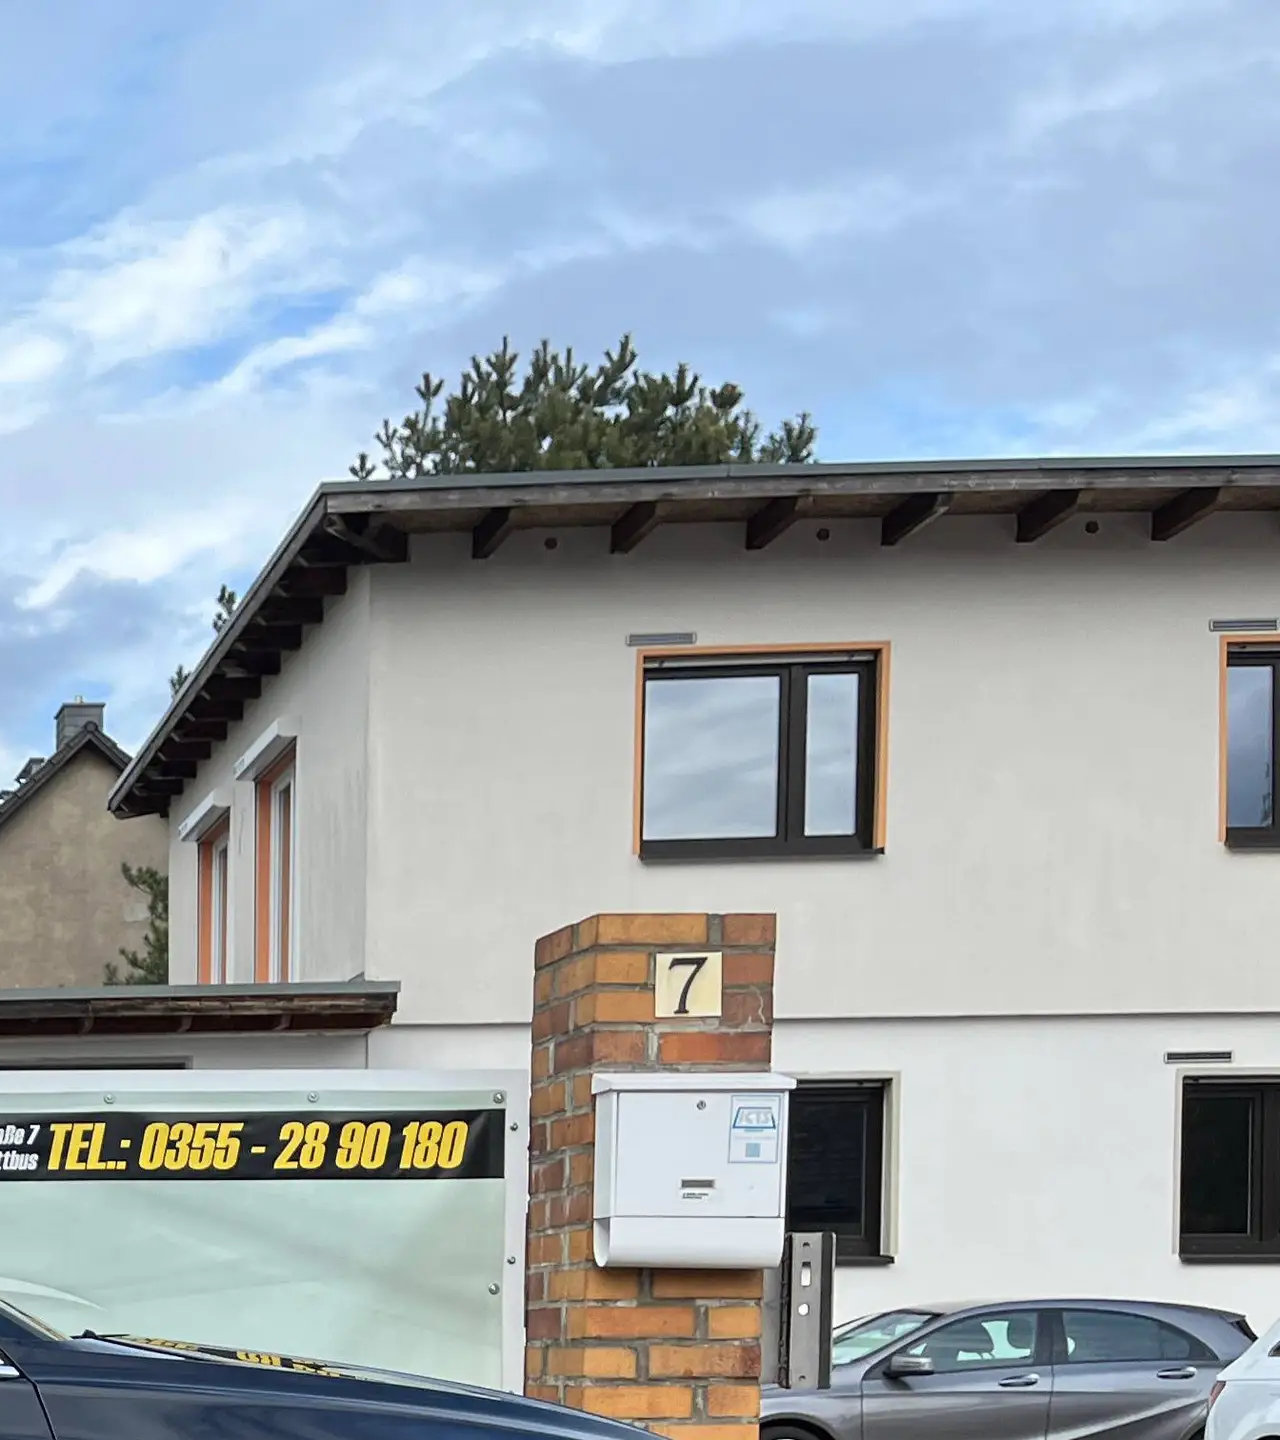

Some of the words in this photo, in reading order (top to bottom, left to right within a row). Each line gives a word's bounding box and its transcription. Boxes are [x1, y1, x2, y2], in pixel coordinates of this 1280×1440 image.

[668, 956, 708, 1015] 7
[27, 1124, 41, 1145] 7
[47, 1122, 131, 1171] TEL.:
[138, 1121, 244, 1171] 0355
[273, 1121, 330, 1170] 28
[335, 1121, 391, 1170] 90
[399, 1121, 469, 1170] 180
